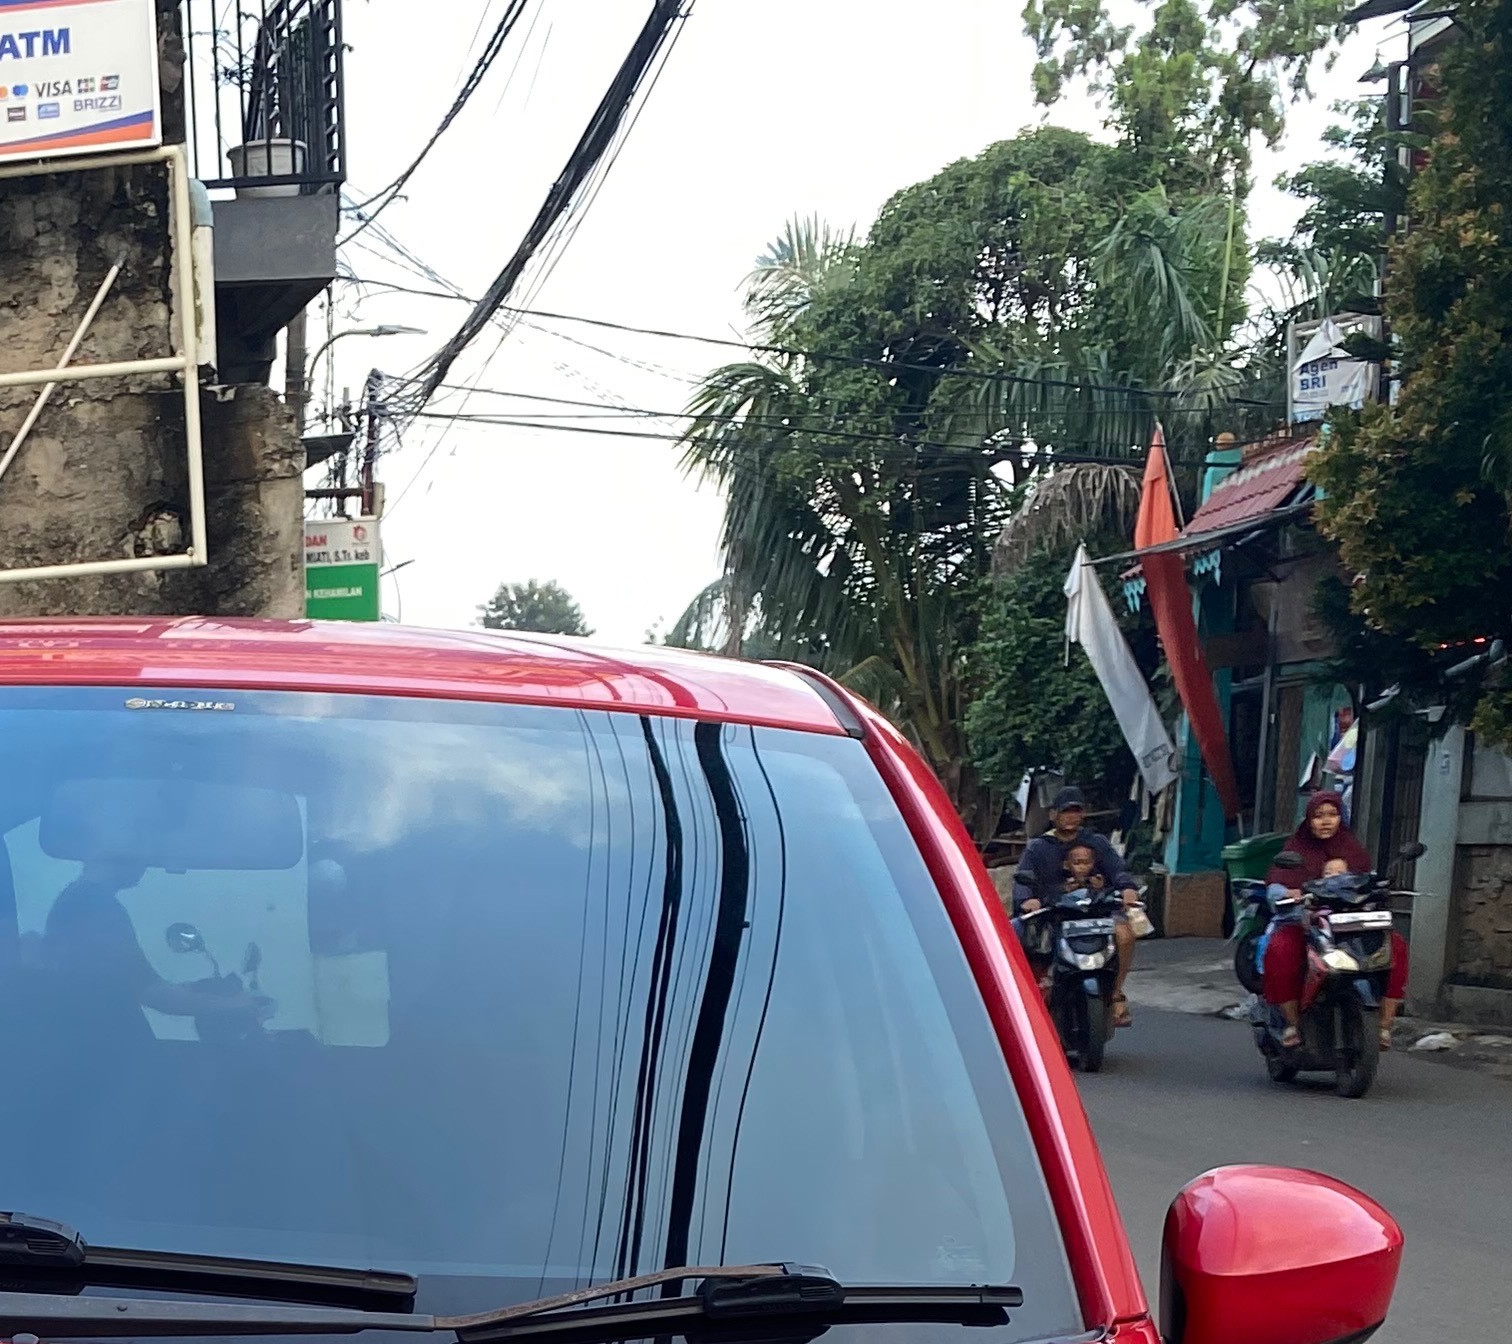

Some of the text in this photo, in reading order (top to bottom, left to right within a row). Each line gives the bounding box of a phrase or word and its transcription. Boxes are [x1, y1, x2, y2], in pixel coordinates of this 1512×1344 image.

[35, 80, 73, 98] VISA
[74, 95, 122, 112] BRIZZI
[1299, 360, 1338, 376] Agen
[1300, 375, 1326, 391] BRI
